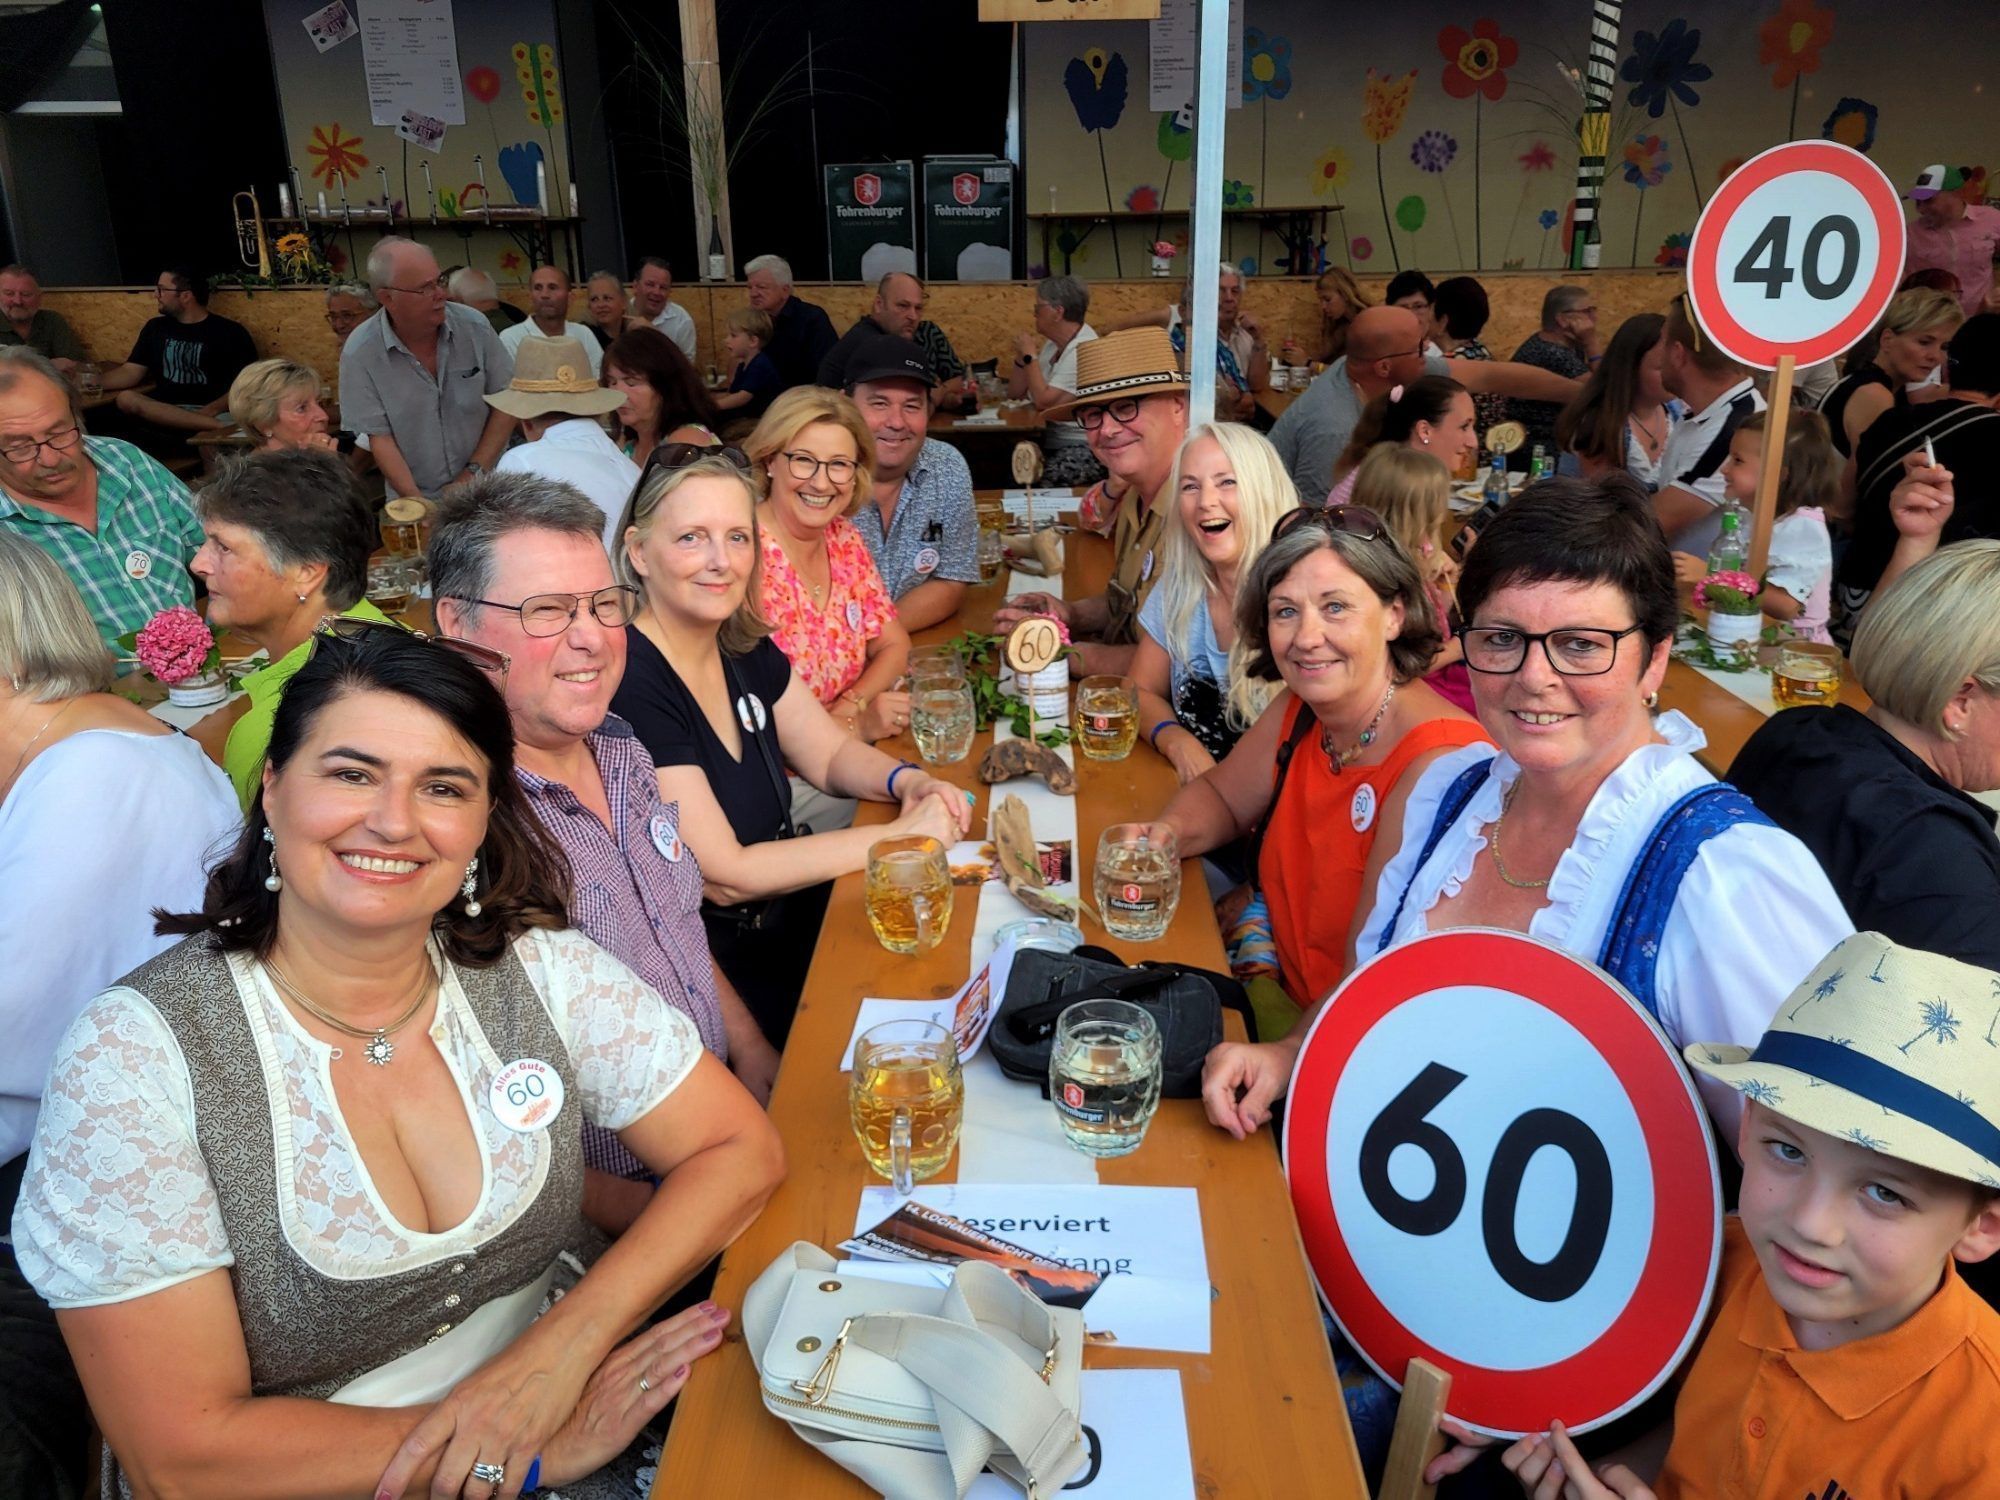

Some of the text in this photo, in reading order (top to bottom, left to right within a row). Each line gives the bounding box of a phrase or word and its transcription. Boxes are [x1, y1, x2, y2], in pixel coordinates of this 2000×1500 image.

[836, 204, 904, 218] Fohrenburger
[934, 204, 1002, 218] Fohrenburger
[1733, 214, 1860, 300] 40
[134, 557, 147, 569] 70
[1019, 625, 1054, 663] 60
[495, 1062, 546, 1092] Alles Gute
[507, 1074, 545, 1106] 60
[1359, 1061, 1613, 1302] 60
[921, 1209, 990, 1243] LOCHAUER
[987, 1237, 1034, 1263] NACHT
